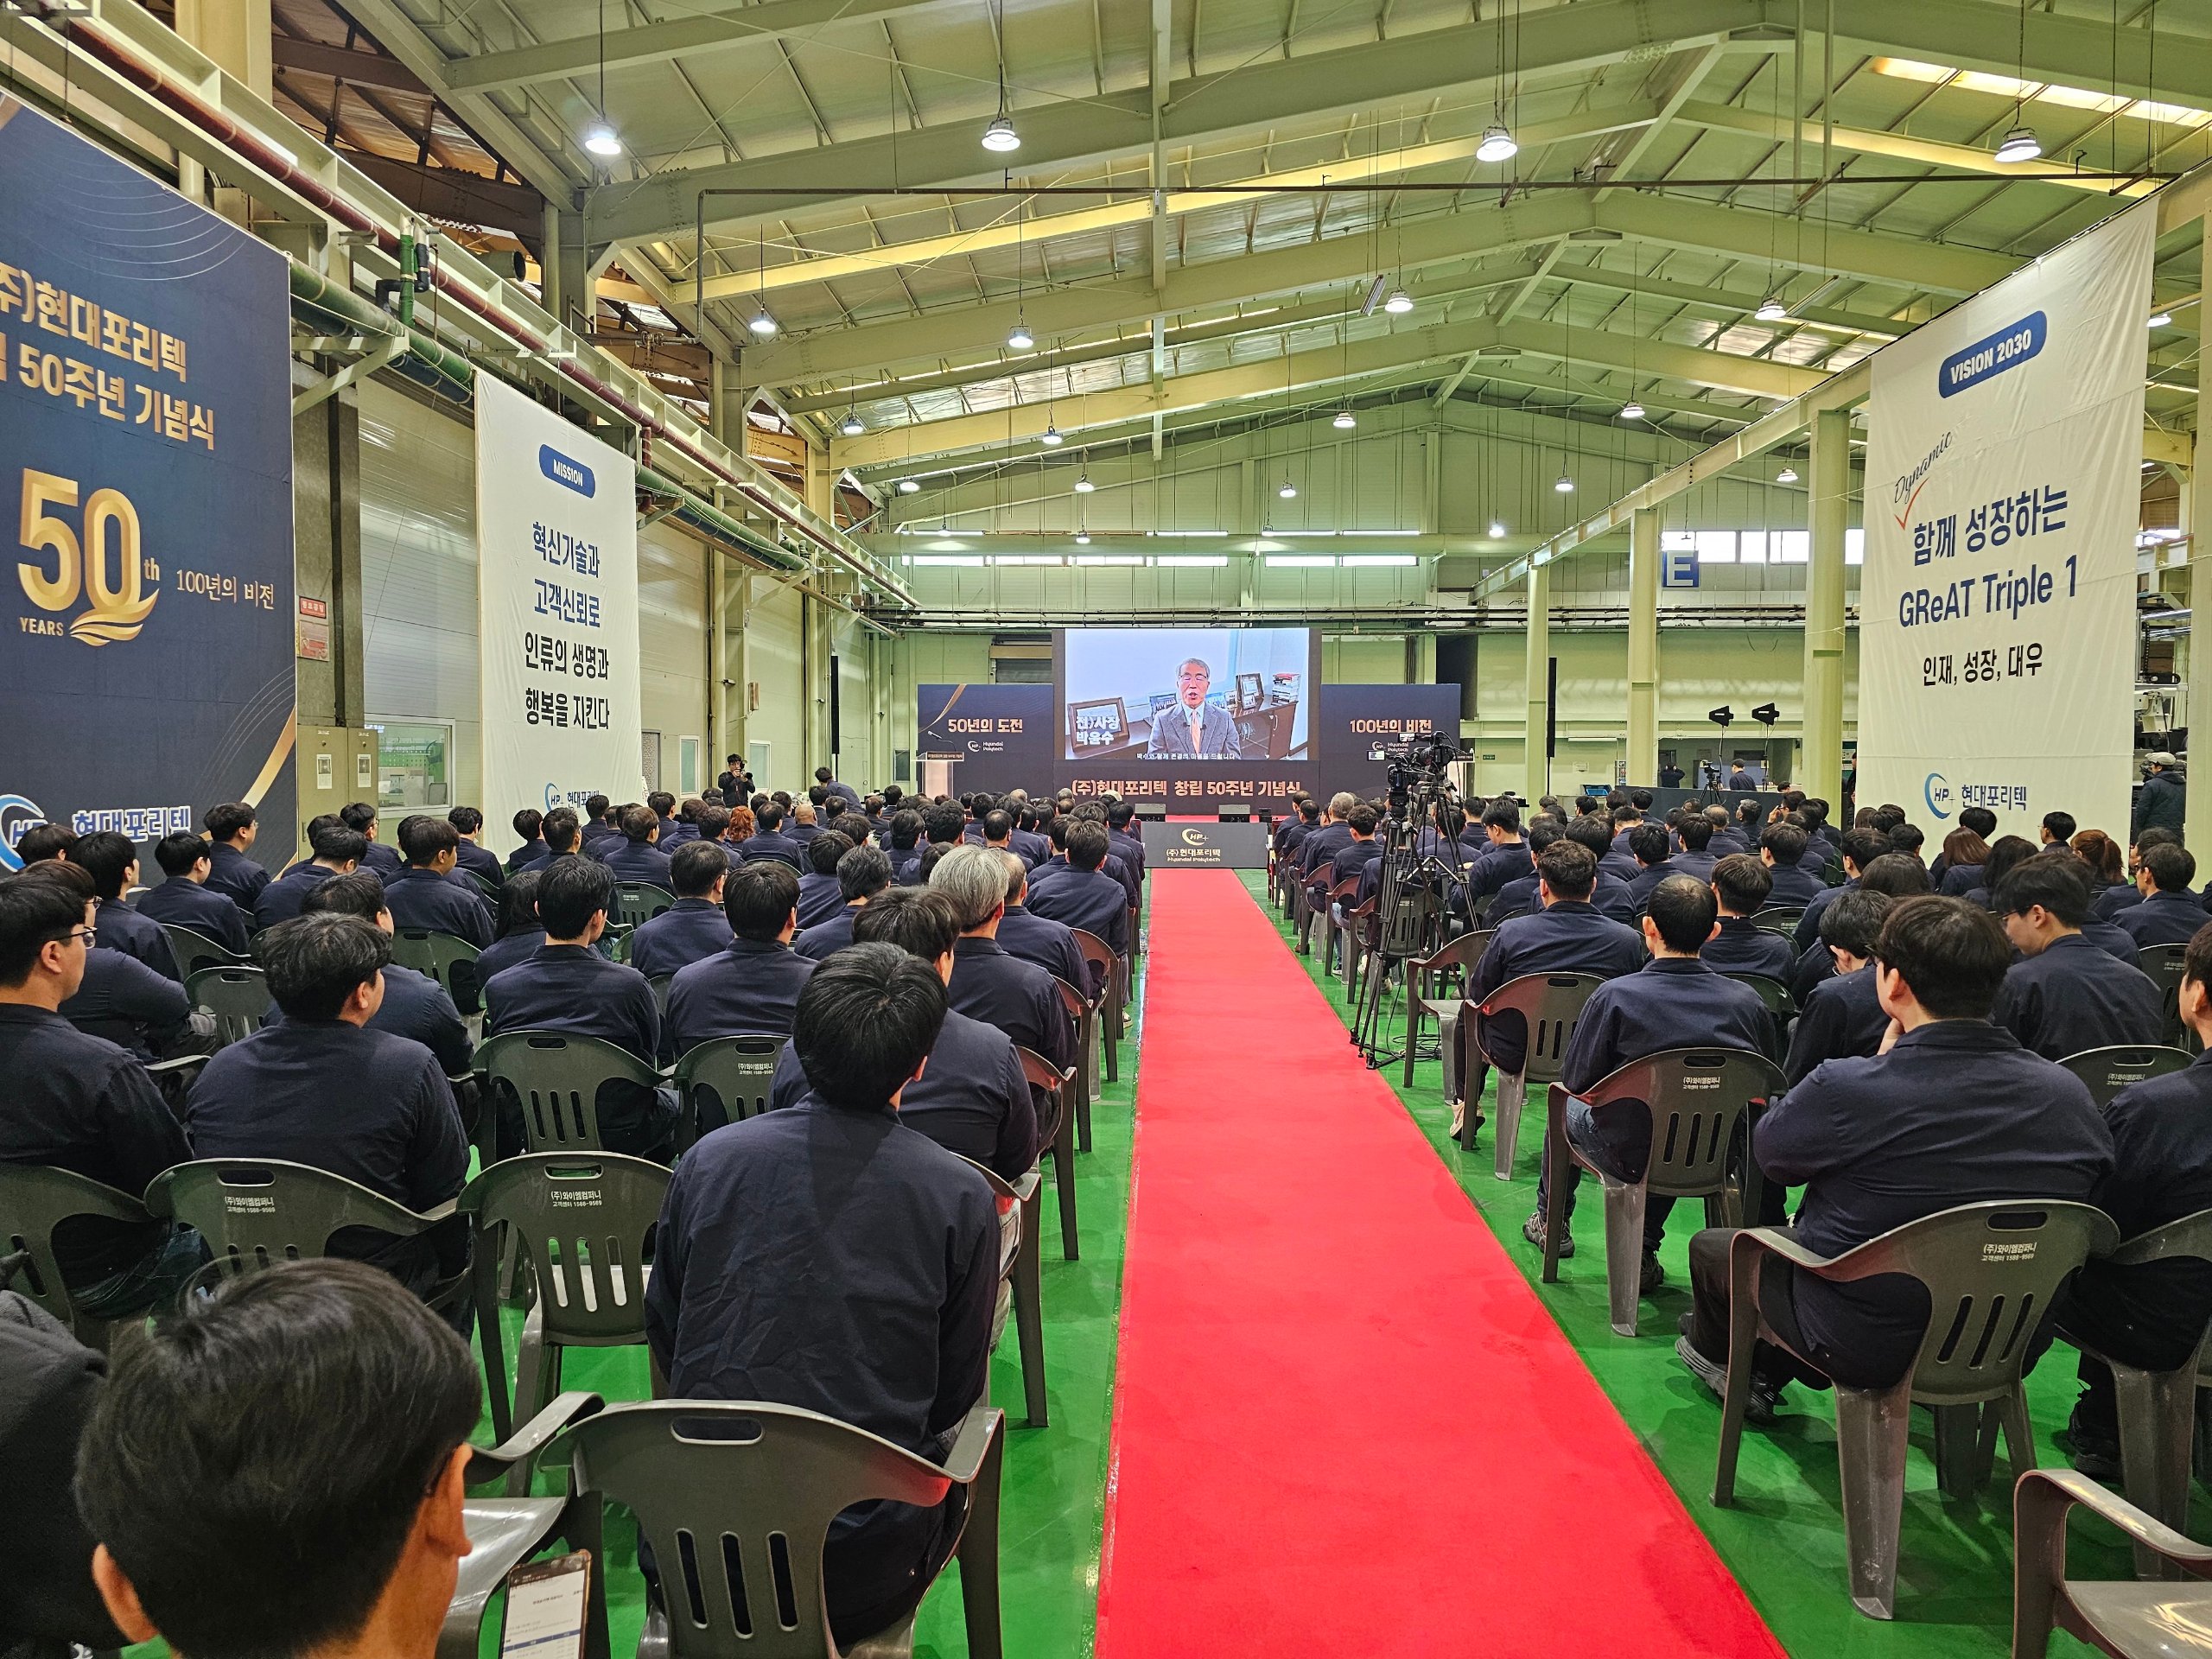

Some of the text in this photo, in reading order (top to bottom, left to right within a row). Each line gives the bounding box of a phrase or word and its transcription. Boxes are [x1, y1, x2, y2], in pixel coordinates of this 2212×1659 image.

[1950, 328, 2032, 385] VISION 2030
[19, 342, 126, 422] 50주년
[135, 383, 214, 450] 기념식
[553, 458, 584, 487] MISSION
[1894, 430, 1954, 505] Dynamic
[1913, 484, 2069, 568] 함께 성장하는
[532, 520, 601, 579] 혁신기술과
[176, 569, 275, 610] 100년의 비전
[1666, 555, 1694, 588] E
[1899, 554, 2077, 628] GReAT Triple 1
[534, 578, 601, 628] 고객신뢰로
[19, 616, 64, 637] YEARS
[524, 631, 609, 681] 인류의 생명과
[1923, 642, 2044, 687] 인재, 성장, 대우
[525, 687, 610, 730] 행복을 지킨다
[948, 719, 1023, 734] 50년의 도전
[1350, 719, 1432, 734] 100년의 비전
[1071, 779, 1168, 796] (주)현대포리텍
[1174, 780, 1203, 797] 창립
[1206, 780, 1254, 797] 50주년
[1961, 784, 2027, 811] 현대포리텍
[550, 1189, 602, 1201] (주)와이엠컴퍼니
[1983, 1242, 2037, 1254] (주)와이엠컴퍼니
